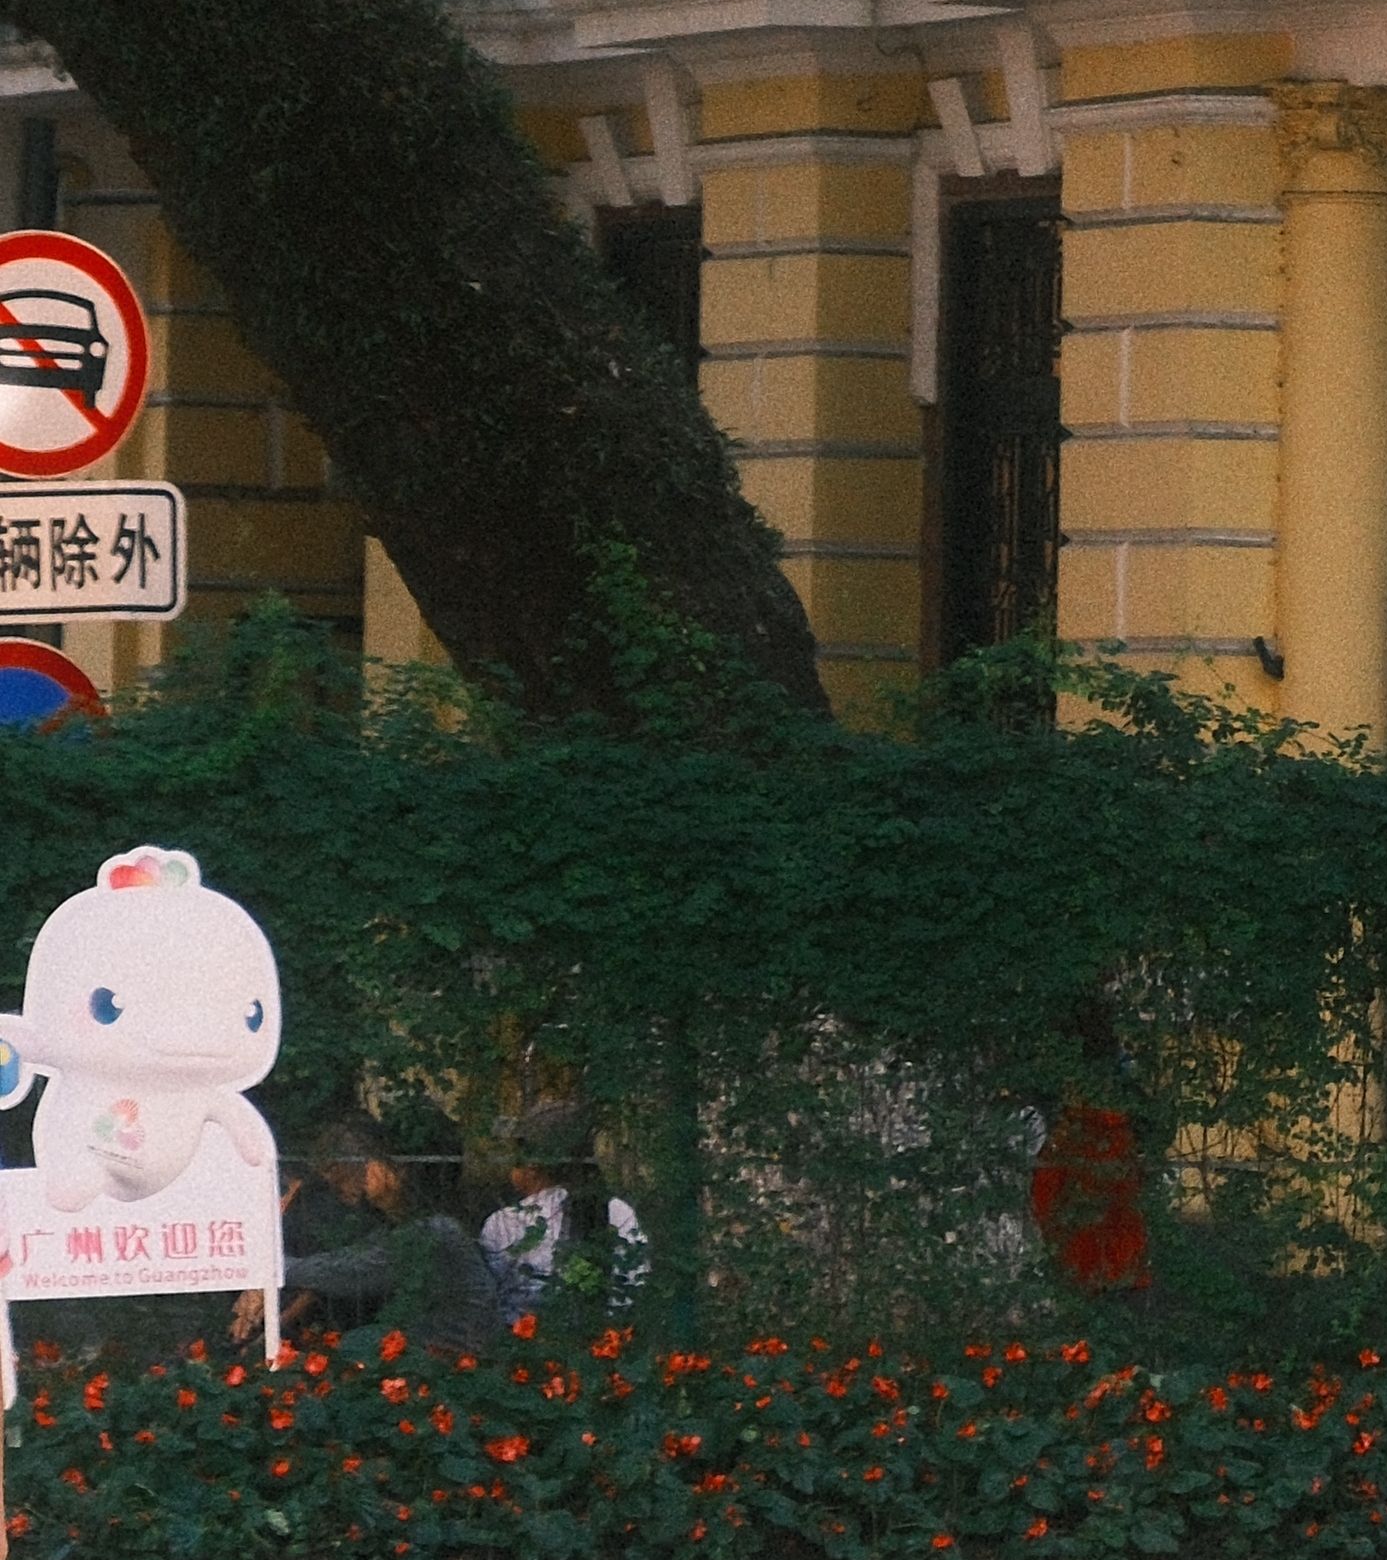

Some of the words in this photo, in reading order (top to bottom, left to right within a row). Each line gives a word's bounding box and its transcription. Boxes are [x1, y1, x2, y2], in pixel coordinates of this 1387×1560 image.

[0, 513, 160, 592] 辆除外
[20, 1220, 246, 1266] 广州欢迎您
[24, 1272, 108, 1288] Welcome
[115, 1272, 133, 1286] to
[138, 1265, 248, 1286] Guangzhou
